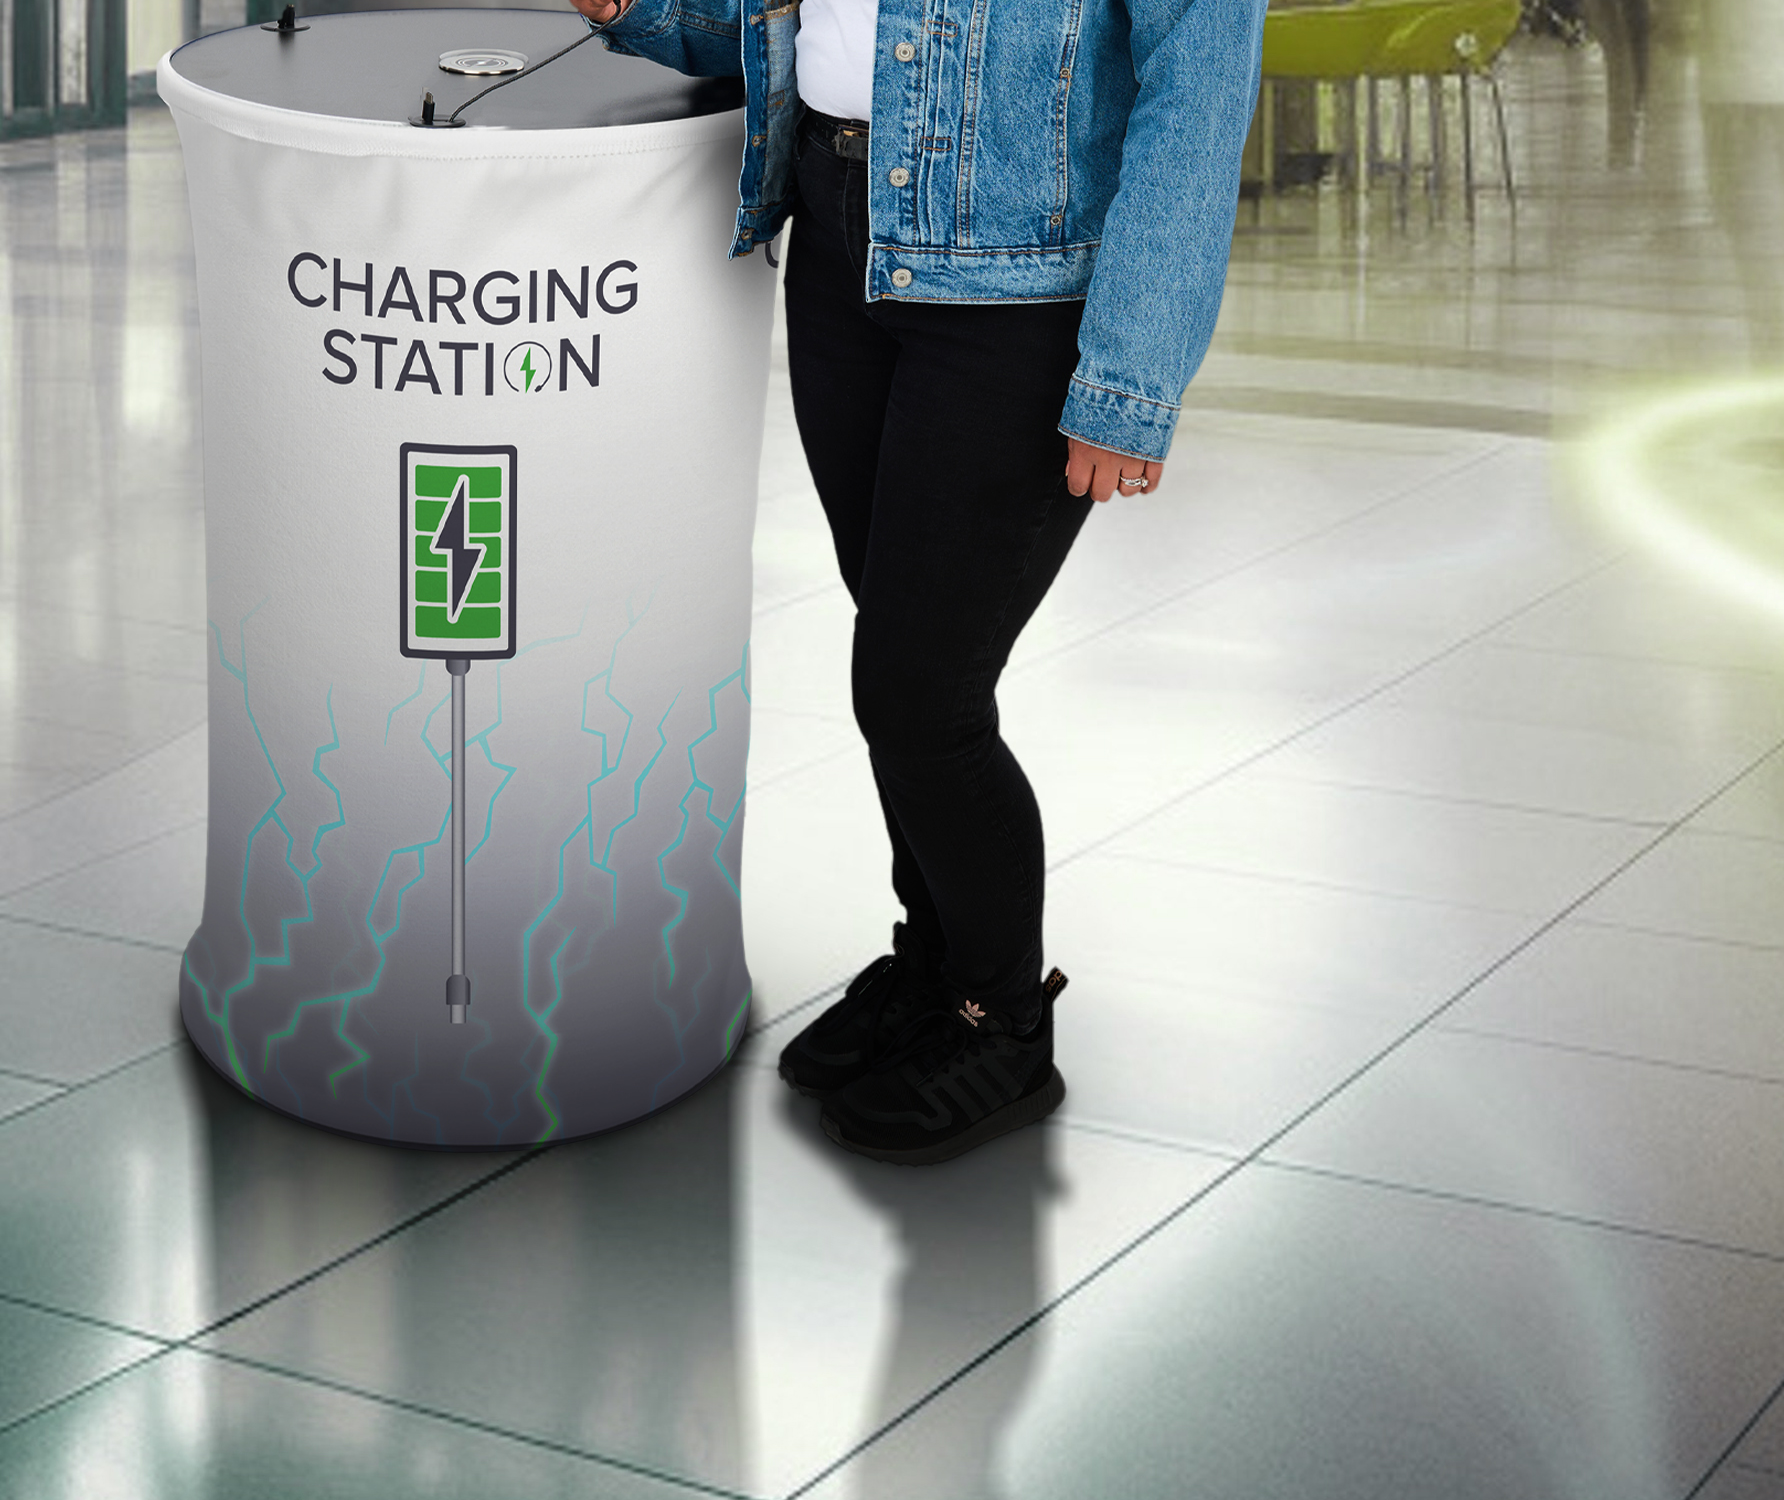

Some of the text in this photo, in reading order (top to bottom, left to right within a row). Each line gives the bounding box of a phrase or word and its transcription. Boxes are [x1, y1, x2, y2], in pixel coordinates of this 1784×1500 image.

[287, 251, 639, 326] CHARGING
[321, 328, 602, 396] STATION
[958, 1008, 979, 1028] adidas
